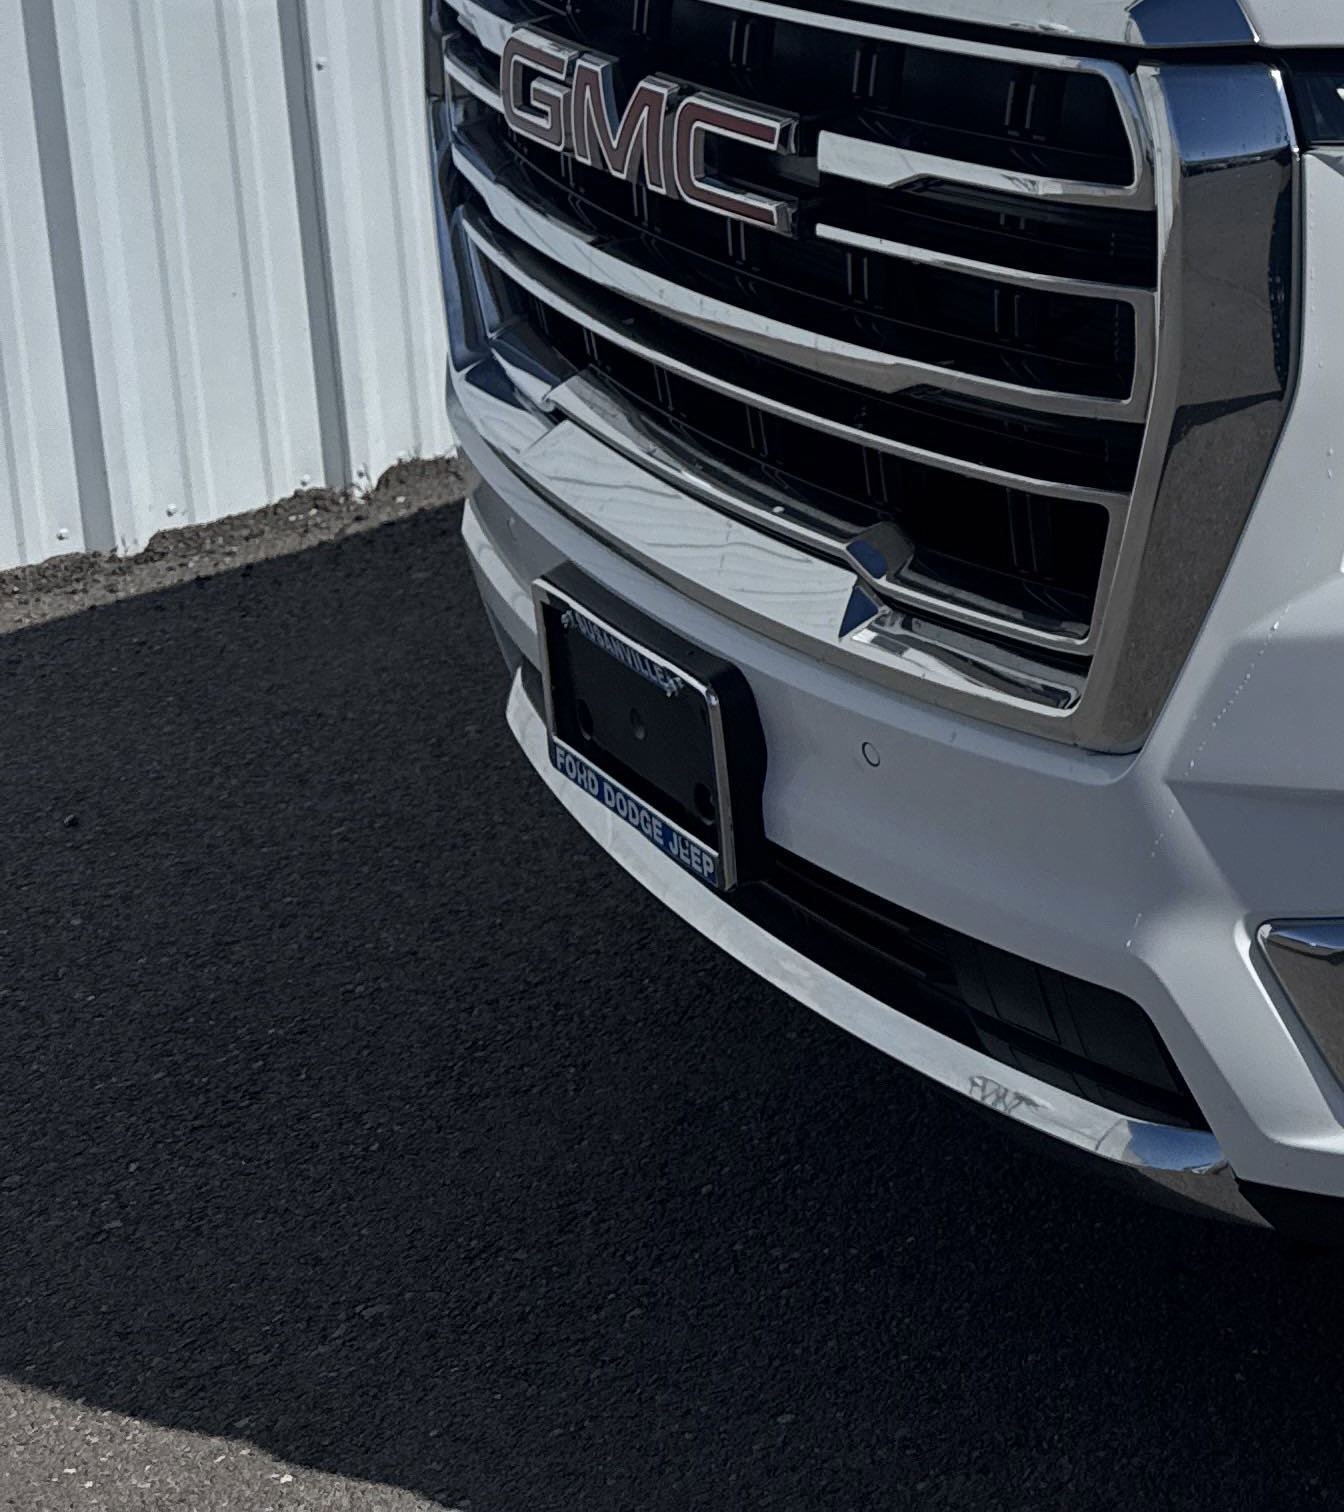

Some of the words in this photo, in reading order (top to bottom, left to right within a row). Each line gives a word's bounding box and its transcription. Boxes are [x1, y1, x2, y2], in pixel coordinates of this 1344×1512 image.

[501, 28, 795, 236] GMC
[603, 782, 663, 846] DODGE
[668, 832, 715, 878] JEEP
